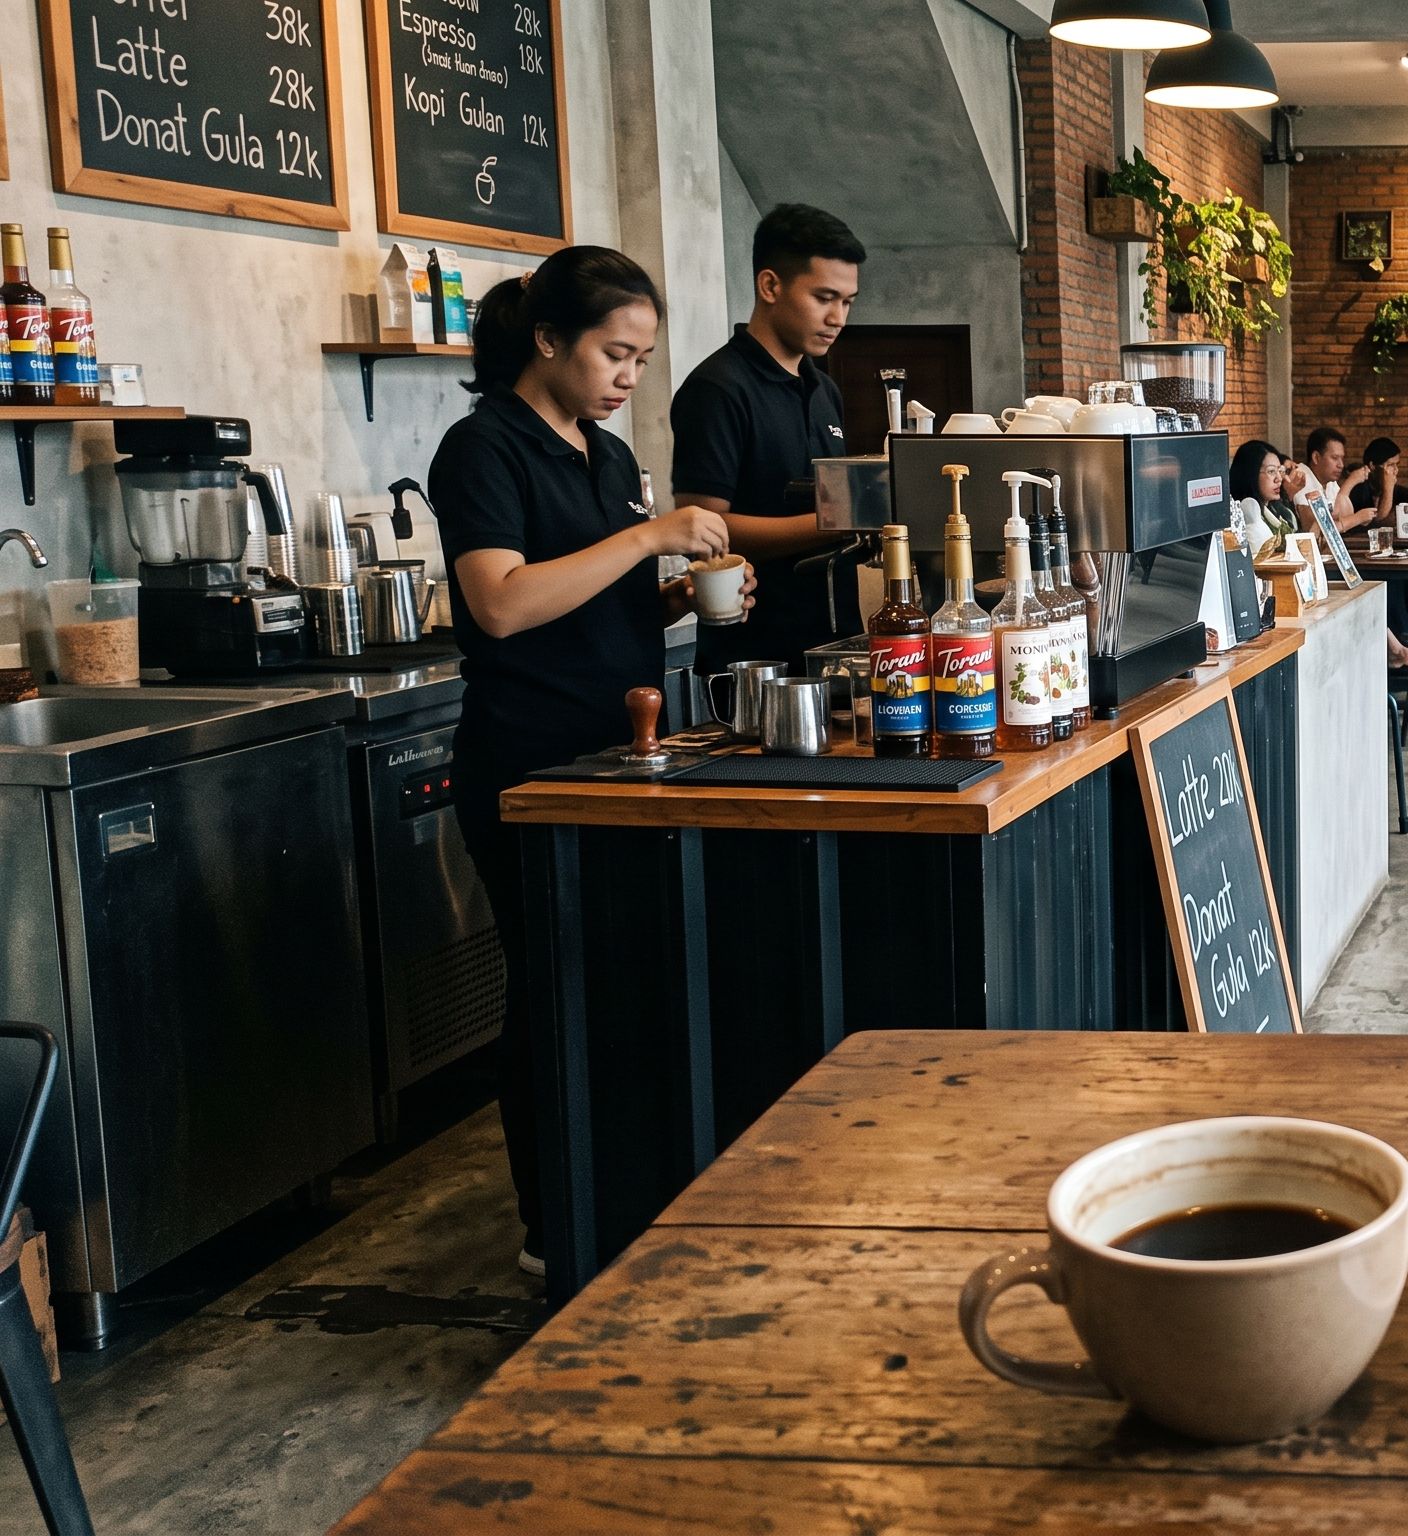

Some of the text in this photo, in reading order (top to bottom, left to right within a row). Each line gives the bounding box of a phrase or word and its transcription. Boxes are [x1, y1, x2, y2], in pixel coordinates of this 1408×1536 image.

[263, 0, 312, 48] 38k
[514, 3, 542, 38] 28k
[92, 15, 316, 112] Latte 28k
[519, 43, 544, 75] 18k
[97, 88, 322, 181] Donat Gula 12k
[404, 72, 549, 148] Kopi Gulan 12k
[871, 643, 926, 679] Torani
[938, 641, 993, 679] Torani
[1159, 753, 1215, 848] Latte
[1183, 860, 1236, 962] Donat
[1211, 919, 1276, 1018] Gula 12k
